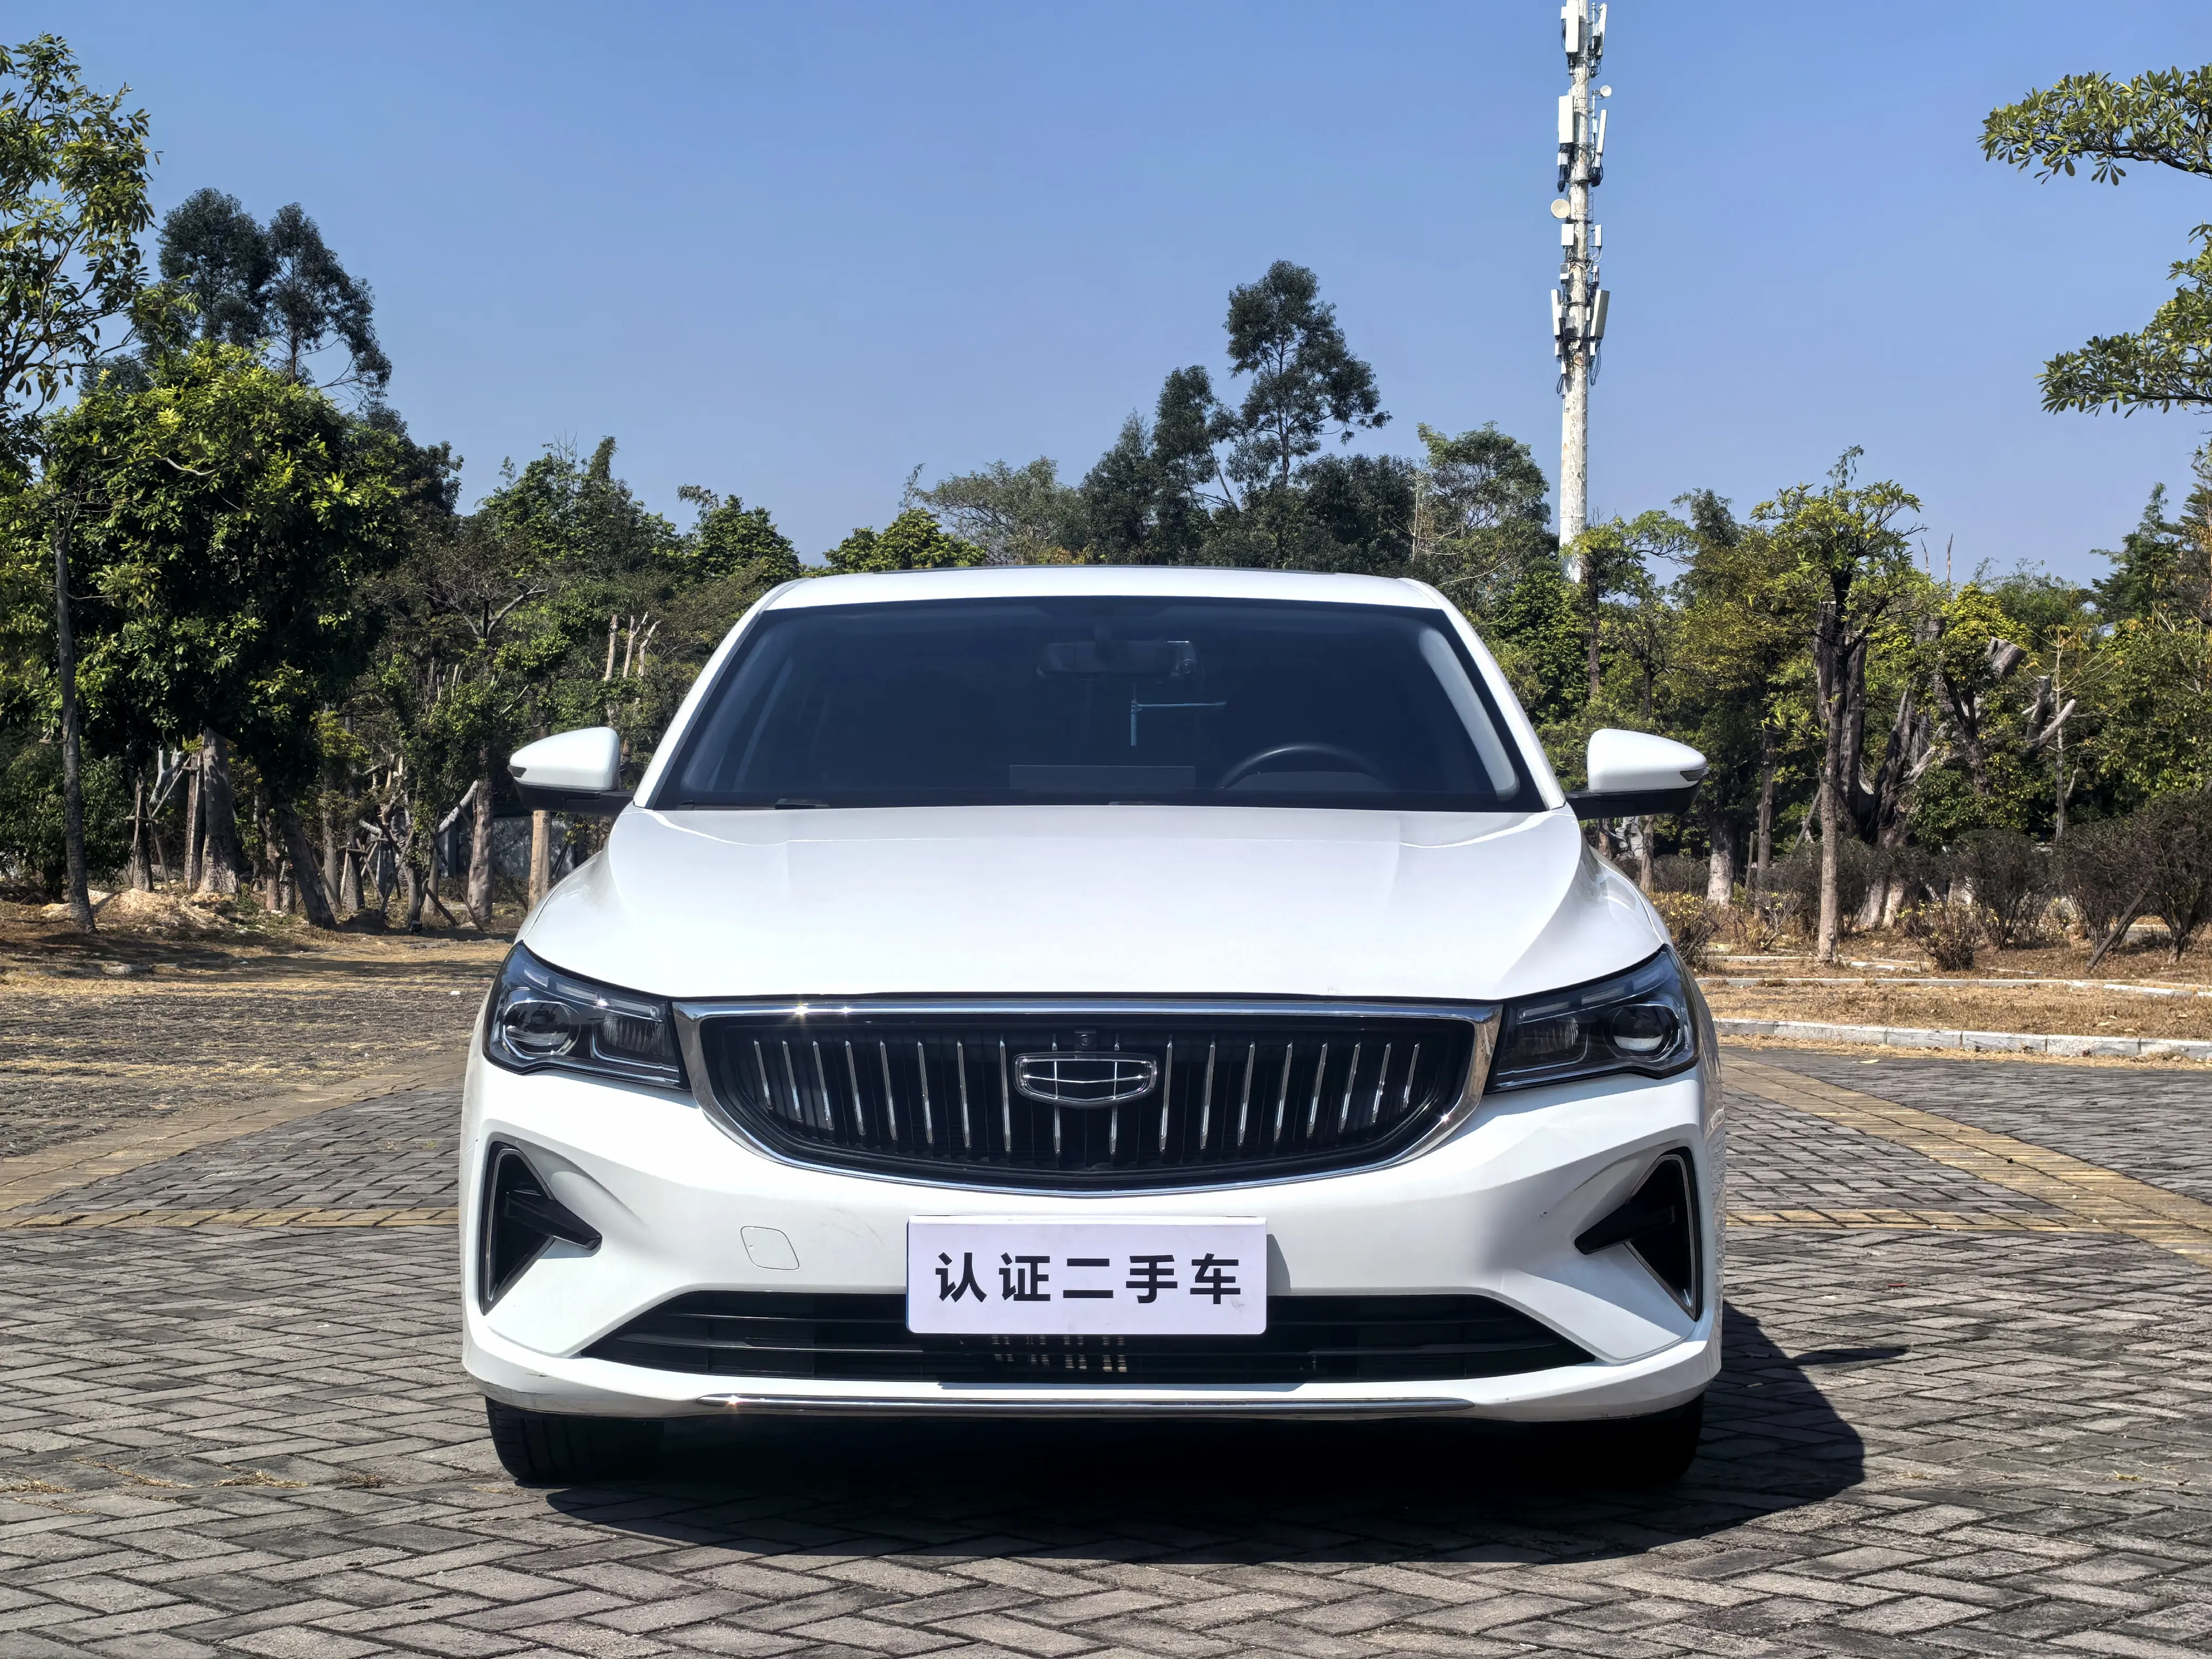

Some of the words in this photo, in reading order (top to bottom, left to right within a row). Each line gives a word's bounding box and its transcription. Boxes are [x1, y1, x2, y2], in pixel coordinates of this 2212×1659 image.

[935, 1252, 1241, 1304] 认证二手车
